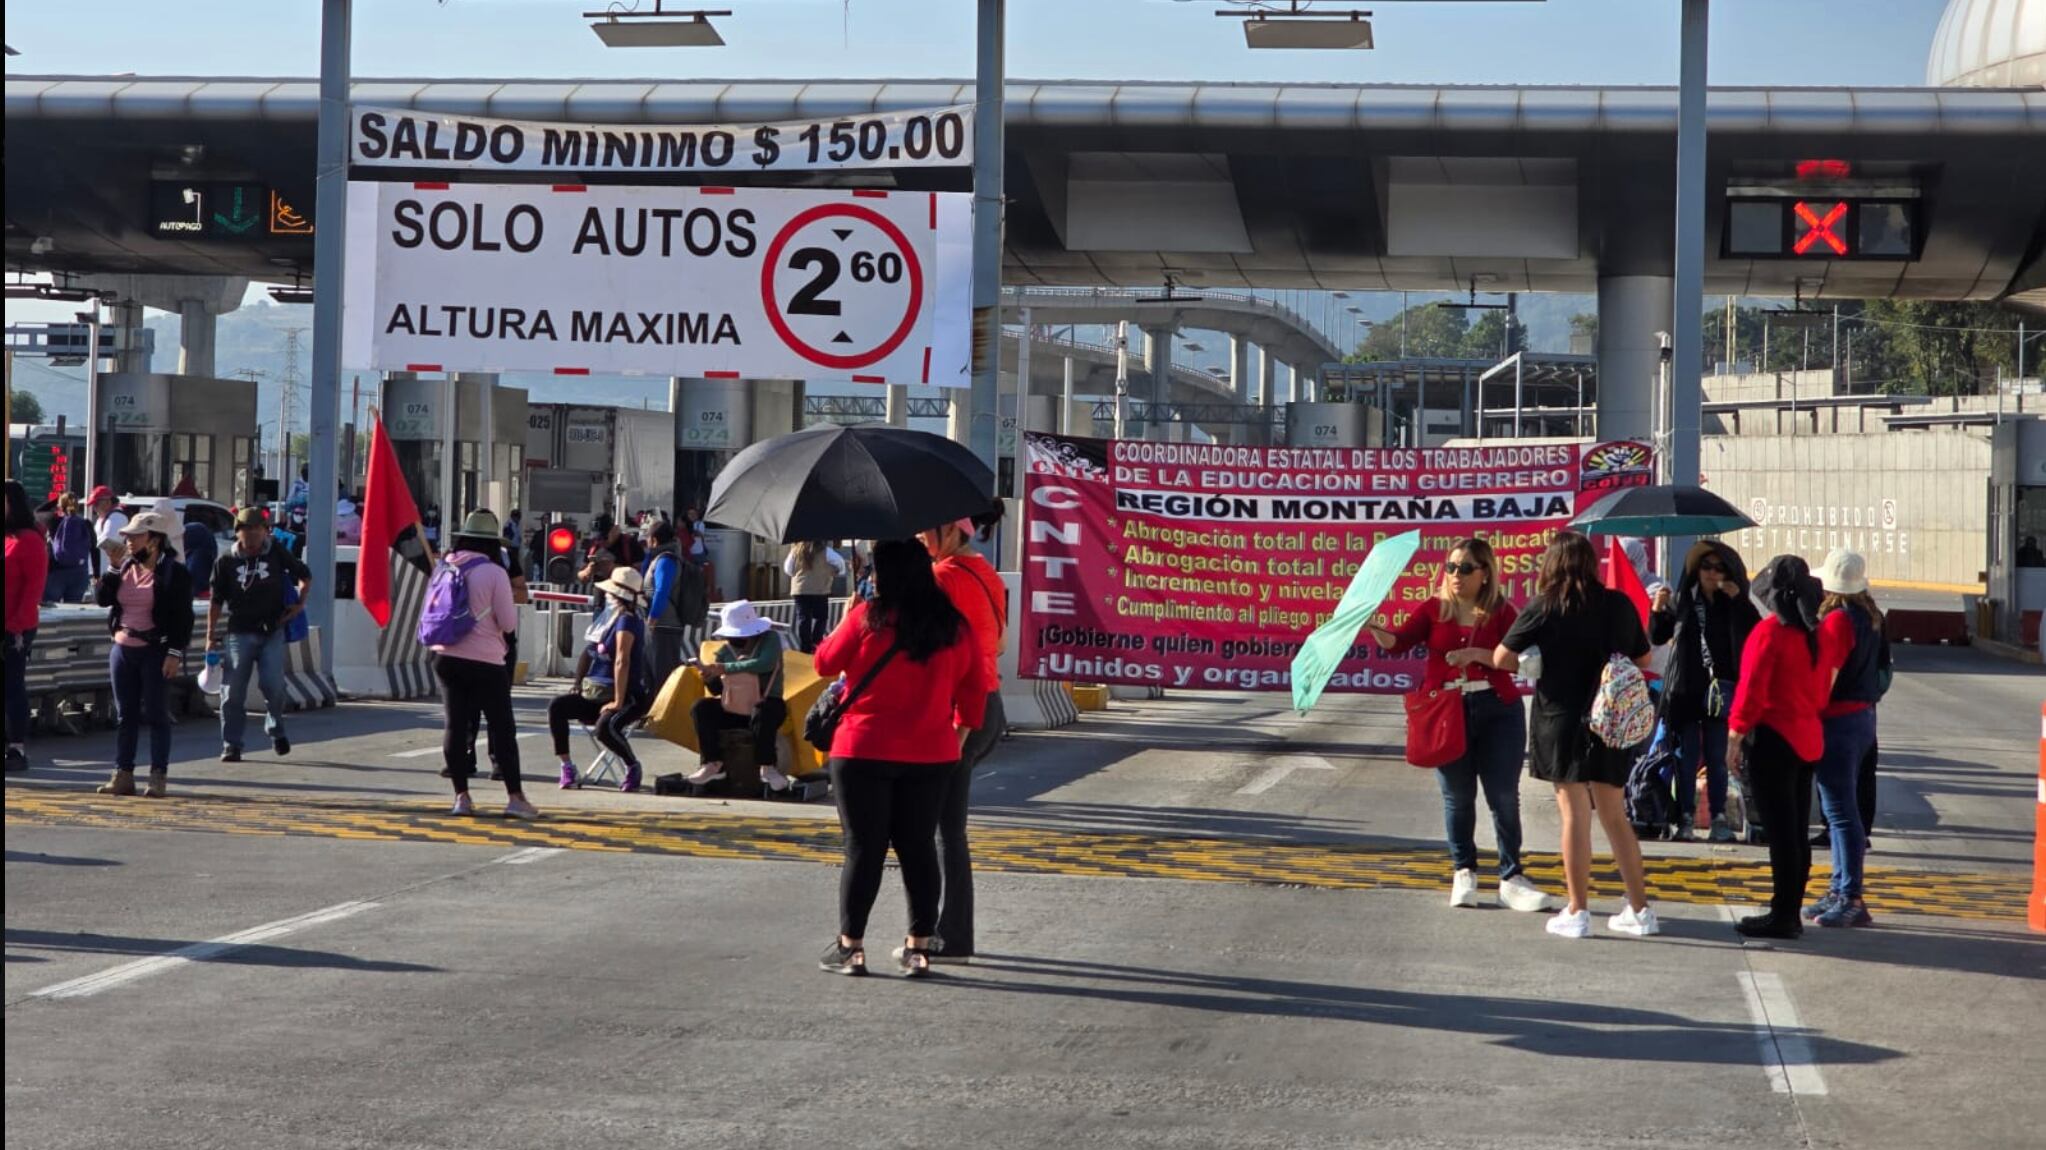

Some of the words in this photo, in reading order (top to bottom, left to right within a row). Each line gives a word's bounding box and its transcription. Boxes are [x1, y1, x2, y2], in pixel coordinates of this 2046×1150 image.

[359, 113, 524, 162] SALDO
[541, 128, 735, 167] MINIMO
[752, 126, 780, 169] $
[800, 112, 964, 163] 150.00
[392, 199, 544, 253] SOLO
[572, 207, 757, 258] AUTOS
[786, 247, 842, 316] 2
[850, 251, 904, 284] 60
[386, 303, 558, 341] ALTURA
[571, 310, 742, 345] MAXIMA
[702, 411, 723, 422] 074
[1314, 425, 1338, 436] 074
[1114, 442, 1263, 468] COORDINADORA
[1267, 448, 1346, 469] ESTATAL
[1352, 448, 1376, 469] DE
[1381, 448, 1417, 469] LOS
[1422, 445, 1570, 469] TRABAJADORES
[1115, 466, 1150, 484] DE
[1158, 469, 1193, 487] LA
[1201, 470, 1362, 490] EDUCACIÓN
[1372, 474, 1408, 490] EN
[1417, 469, 1570, 490] GUERRERO
[1117, 491, 1258, 520] REGIÓN
[1272, 494, 1460, 520] MONTAÑA
[1472, 495, 1571, 519] BAJA
[1766, 505, 1876, 527] PROHIBIDO
[1123, 519, 1245, 549] Abrogación
[1253, 531, 1305, 550] total
[1311, 531, 1338, 550] de
[1345, 531, 1366, 551] la
[1741, 528, 1908, 553] ESTACIONARSE
[1124, 544, 1259, 573] Abrogación
[1266, 557, 1324, 576] total
[1331, 557, 1358, 577] de
[1124, 568, 1256, 597] Incremento
[1258, 583, 1272, 601] y
[1117, 596, 1234, 622] Cumplimiento
[1238, 606, 1256, 622] al
[1259, 606, 1310, 629] pliego
[1152, 631, 1216, 657] quien
[1172, 664, 1193, 686] y
